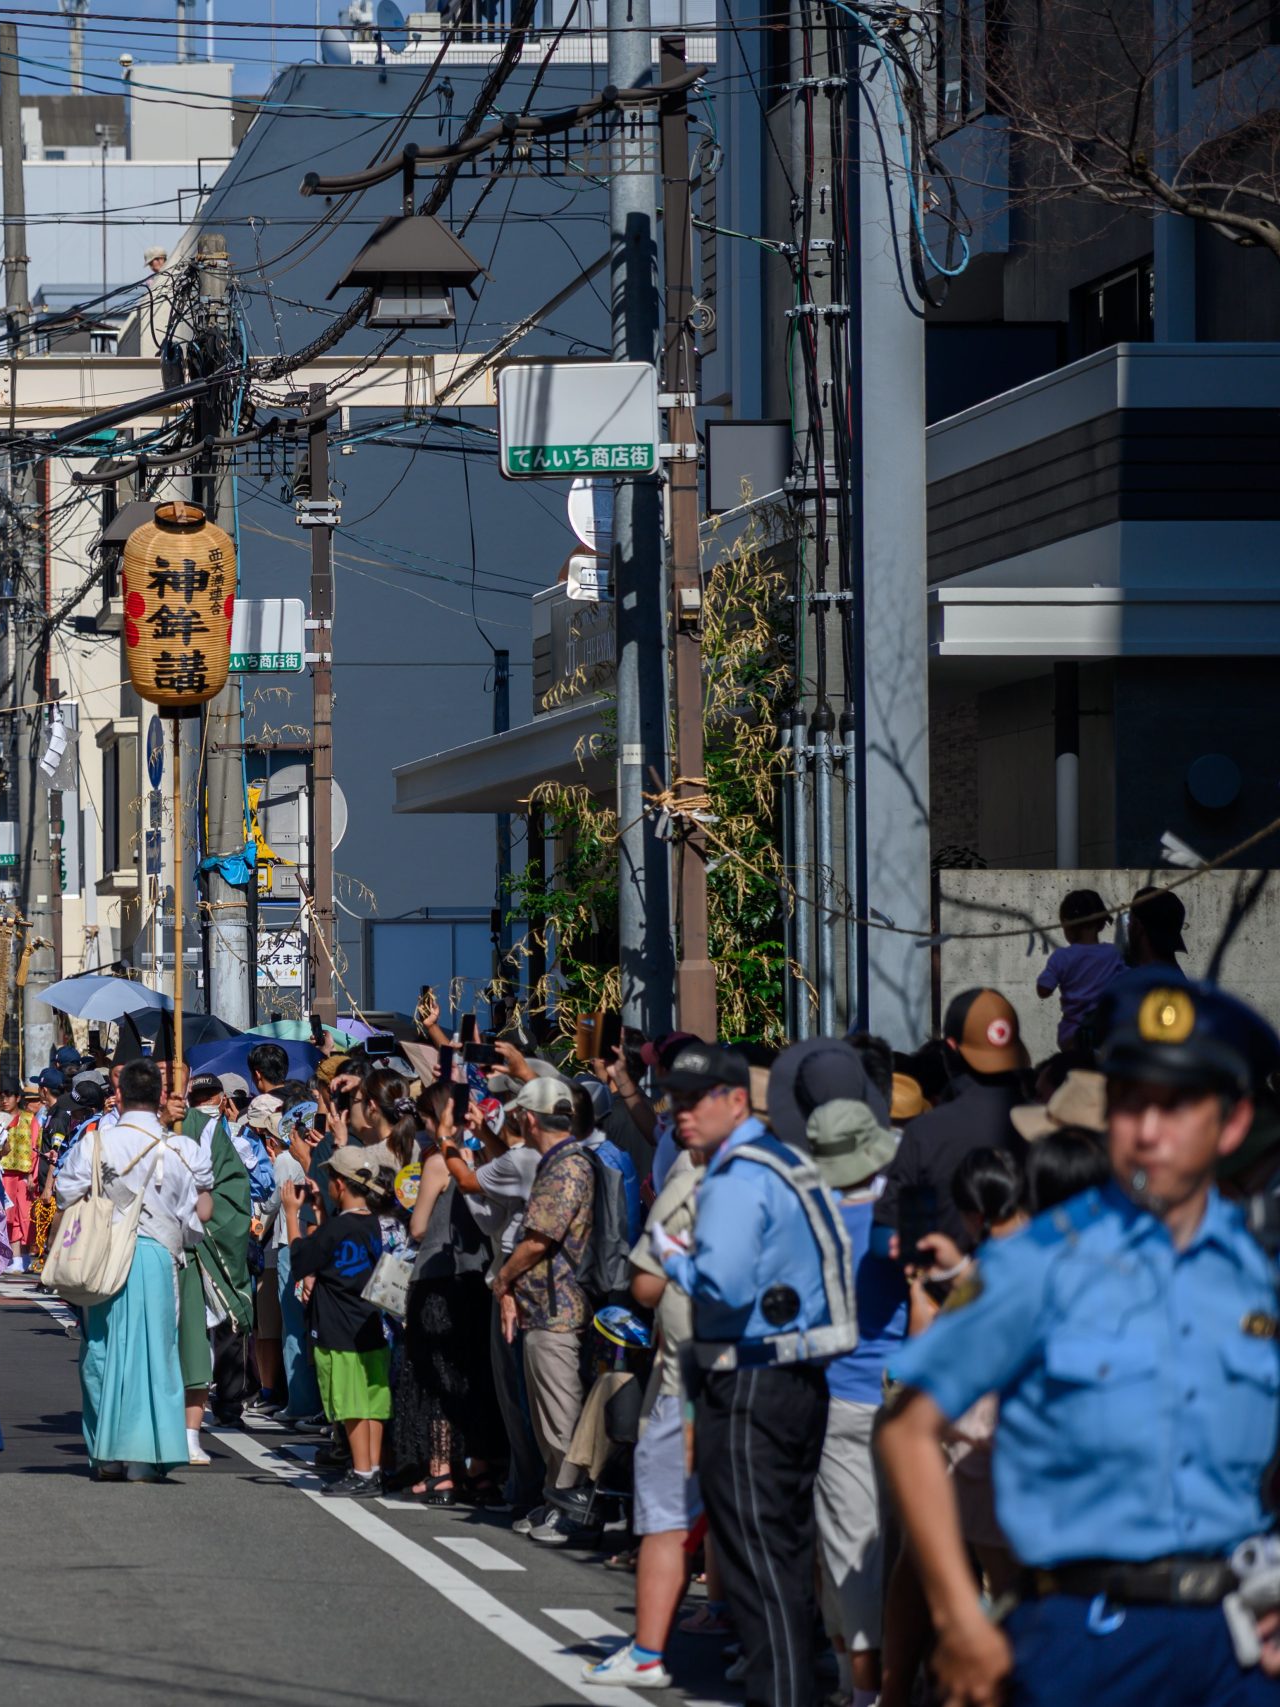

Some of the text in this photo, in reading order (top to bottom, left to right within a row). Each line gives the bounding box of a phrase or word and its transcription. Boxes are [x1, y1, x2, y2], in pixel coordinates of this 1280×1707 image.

[513, 445, 649, 468] てんいち商店街
